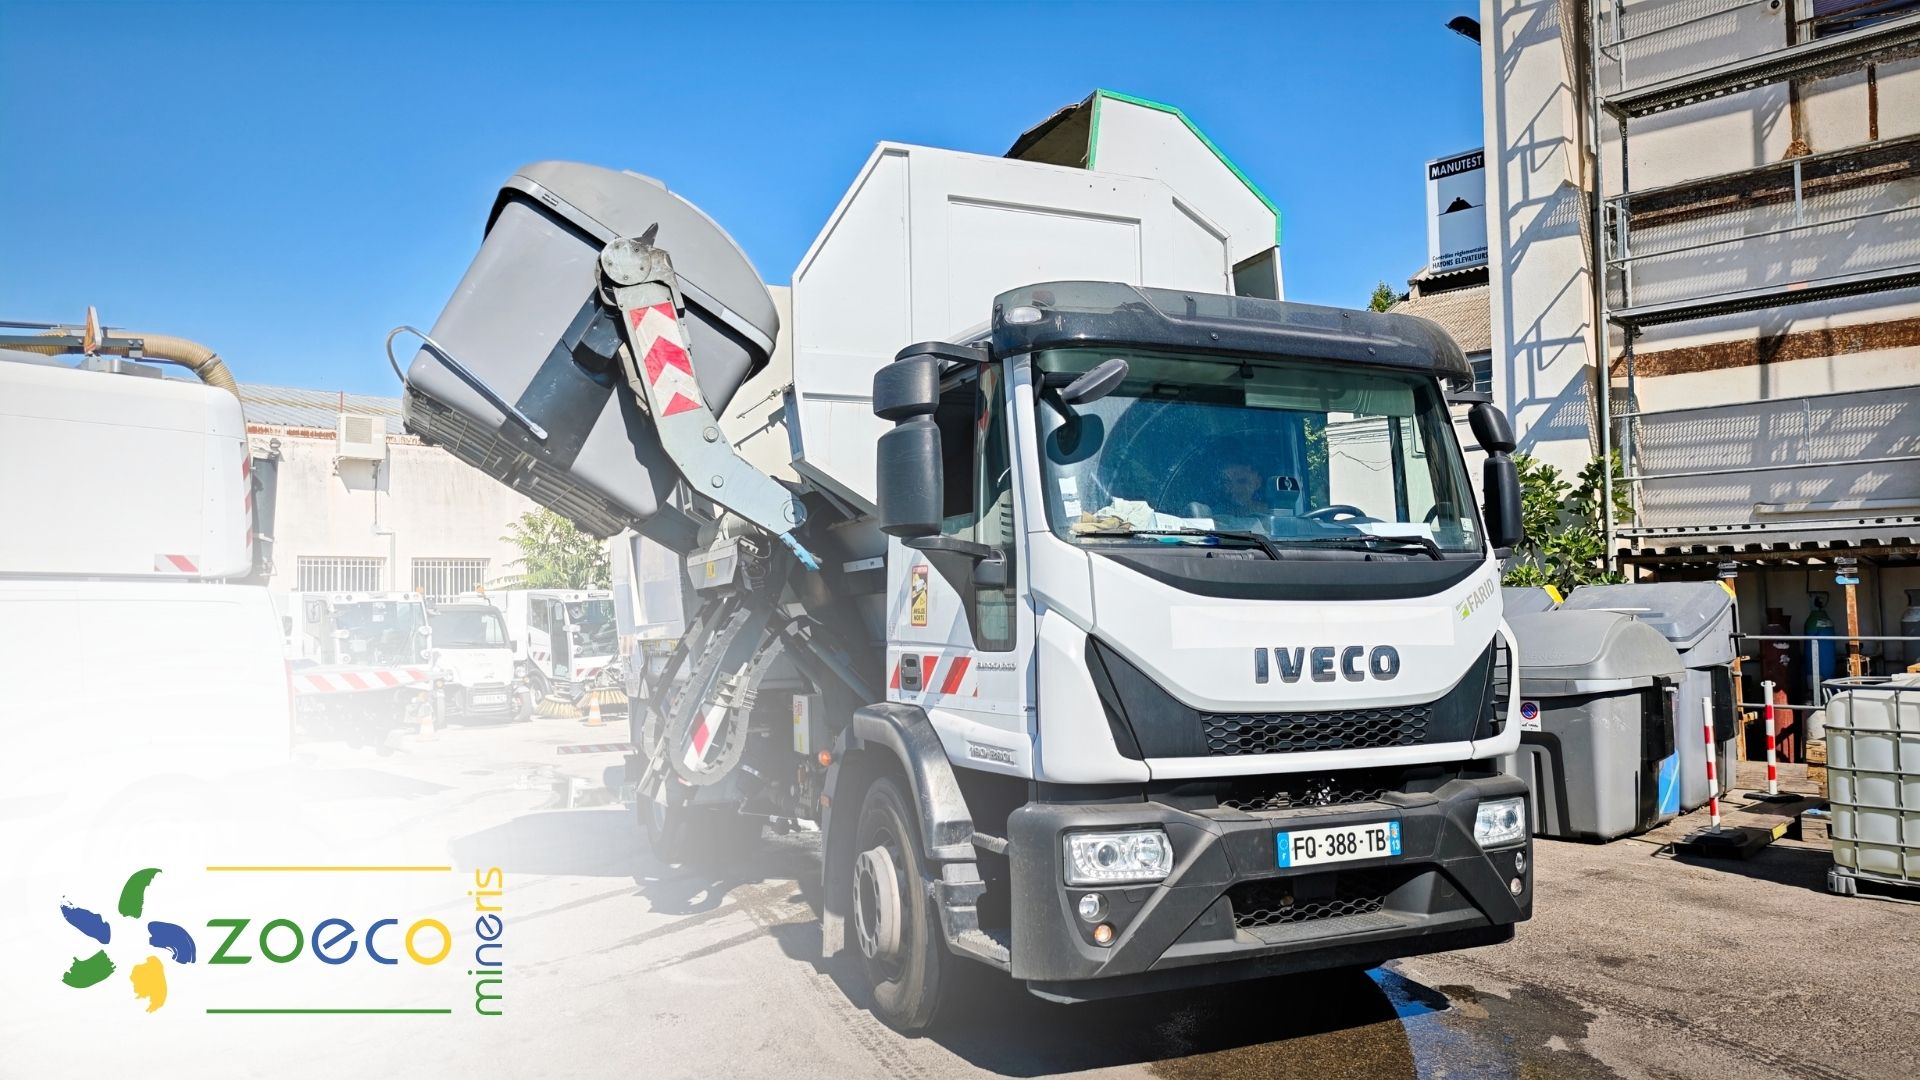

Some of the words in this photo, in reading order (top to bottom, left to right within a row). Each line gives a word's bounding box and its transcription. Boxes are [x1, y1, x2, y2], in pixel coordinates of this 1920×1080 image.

[1431, 155, 1482, 178] MANUTEST
[1432, 259, 1454, 269] HAYONS
[1454, 252, 1488, 265] ELEVATEURS
[1466, 579, 1494, 612] FARID
[1254, 644, 1400, 684] IVECO
[1293, 829, 1386, 860] FQ-388-TB
